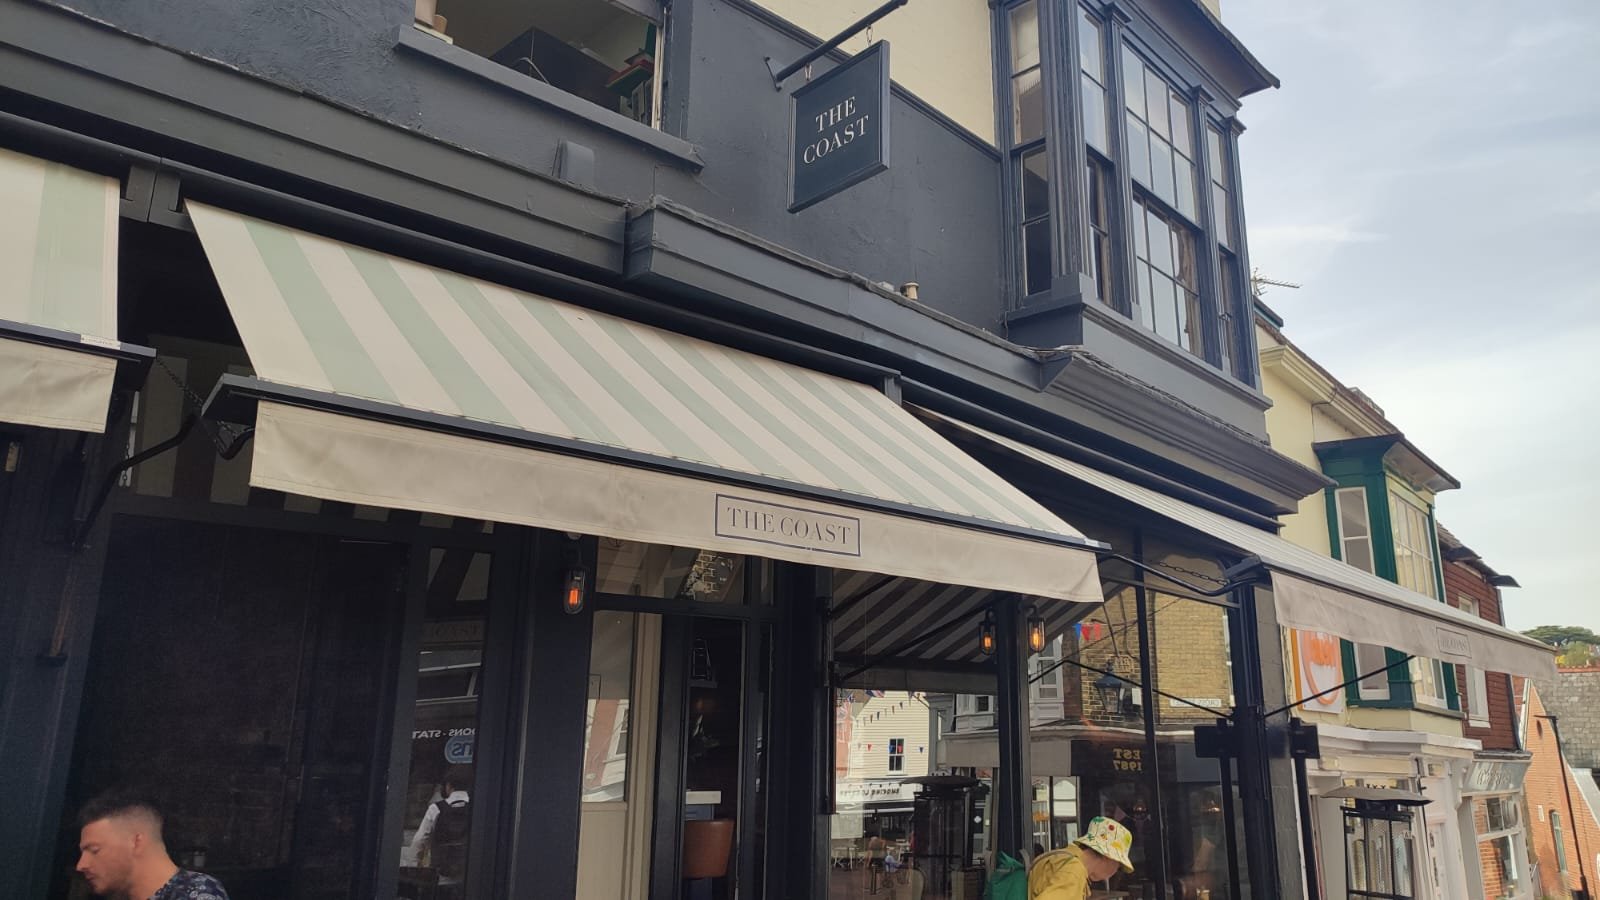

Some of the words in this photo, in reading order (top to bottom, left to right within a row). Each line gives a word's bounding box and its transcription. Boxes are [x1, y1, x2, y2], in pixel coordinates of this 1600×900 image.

[815, 96, 856, 133] THE
[803, 115, 869, 164] COAST
[727, 507, 774, 533] THE
[780, 516, 850, 544] COAST
